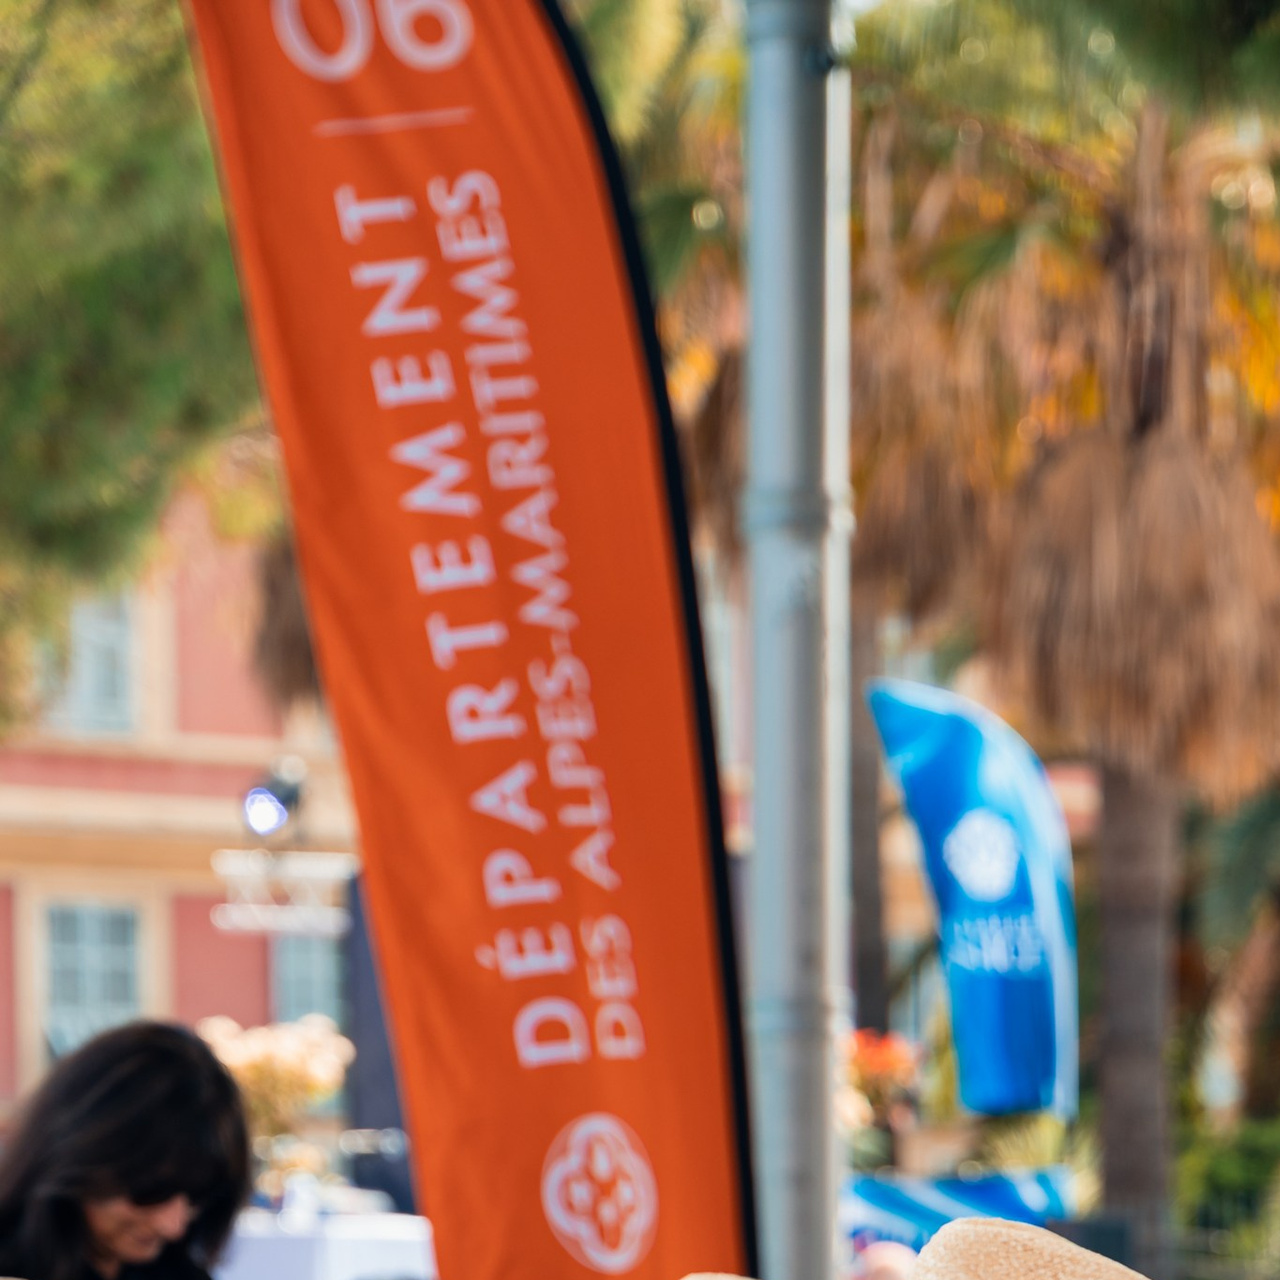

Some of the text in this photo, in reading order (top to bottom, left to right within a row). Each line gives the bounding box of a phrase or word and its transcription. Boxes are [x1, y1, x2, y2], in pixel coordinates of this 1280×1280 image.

[334, 184, 594, 1069] DÉPARTEMENT
[427, 169, 647, 1061] DES ALPES-MARITIMES
